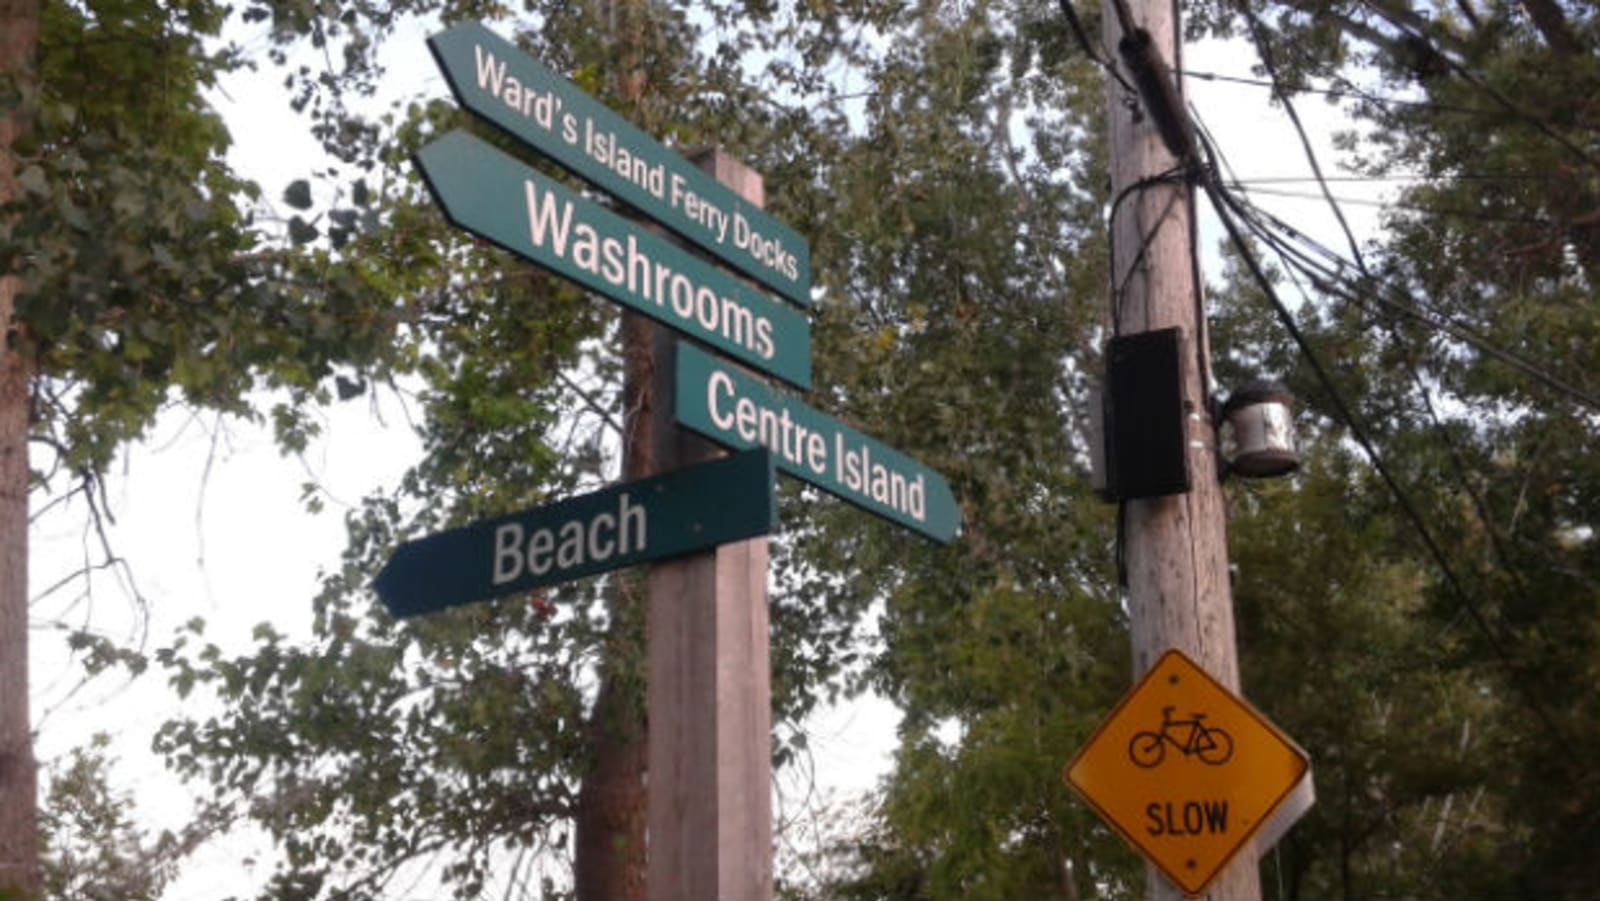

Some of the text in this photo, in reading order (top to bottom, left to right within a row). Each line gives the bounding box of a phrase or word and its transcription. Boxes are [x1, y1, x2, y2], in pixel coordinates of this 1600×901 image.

[475, 44, 799, 282] Ward's Island Ferry Docks
[525, 180, 776, 361] Washrooms
[707, 370, 926, 522] Centre Island
[492, 493, 647, 586] Beach
[1146, 800, 1229, 836] SLOW
